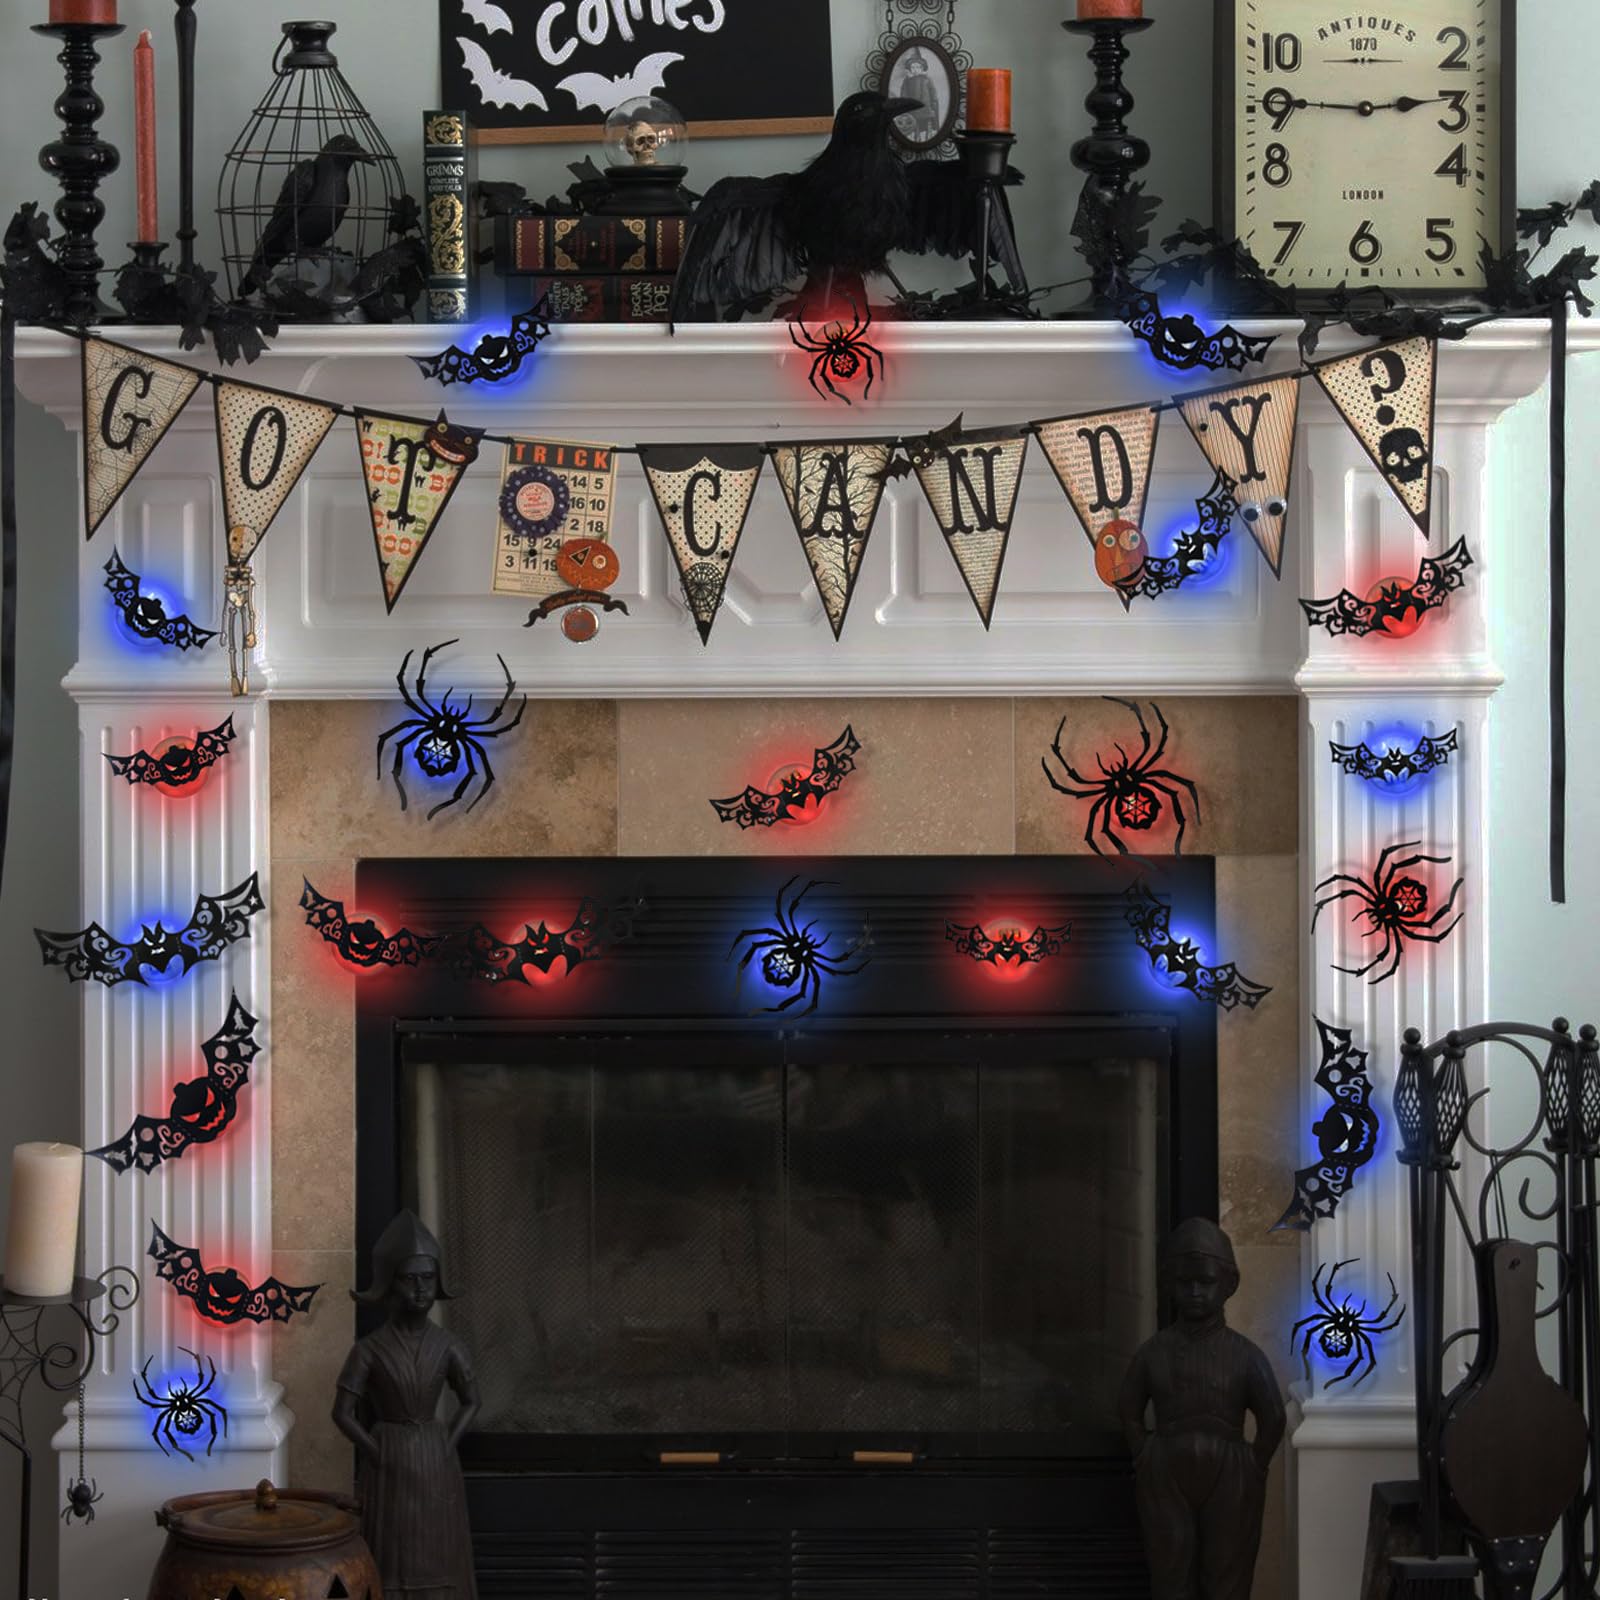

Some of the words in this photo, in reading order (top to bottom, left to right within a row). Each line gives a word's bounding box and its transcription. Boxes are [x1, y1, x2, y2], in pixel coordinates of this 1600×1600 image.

[1317, 16, 1417, 42] ANTIQUES
[1261, 32, 1301, 72] 10
[1350, 37, 1377, 51] 1870
[1436, 26, 1470, 71] 2
[1261, 87, 1296, 132] 9
[1437, 90, 1470, 133] 3
[1262, 142, 1292, 187] 8
[1433, 142, 1471, 187] 4
[1342, 190, 1384, 201] LONDON
[1273, 221, 1306, 265] 7
[1349, 220, 1382, 265] 6
[1425, 217, 1457, 264] 5
[561, 287, 570, 310] TALES
[574, 284, 585, 312] POEMS
[631, 281, 643, 317] EDGAR
[642, 281, 653, 316] ALLAN
[653, 284, 671, 313] POE
[514, 443, 609, 470] TRICK
[570, 475, 587, 488] 14
[594, 478, 604, 490] 5
[589, 499, 606, 511] 10
[570, 518, 580, 531] 2
[587, 520, 604, 533] 18
[503, 534, 520, 547] 15
[544, 537, 561, 550] 24
[505, 555, 515, 568] 3
[522, 557, 537, 570] 11
